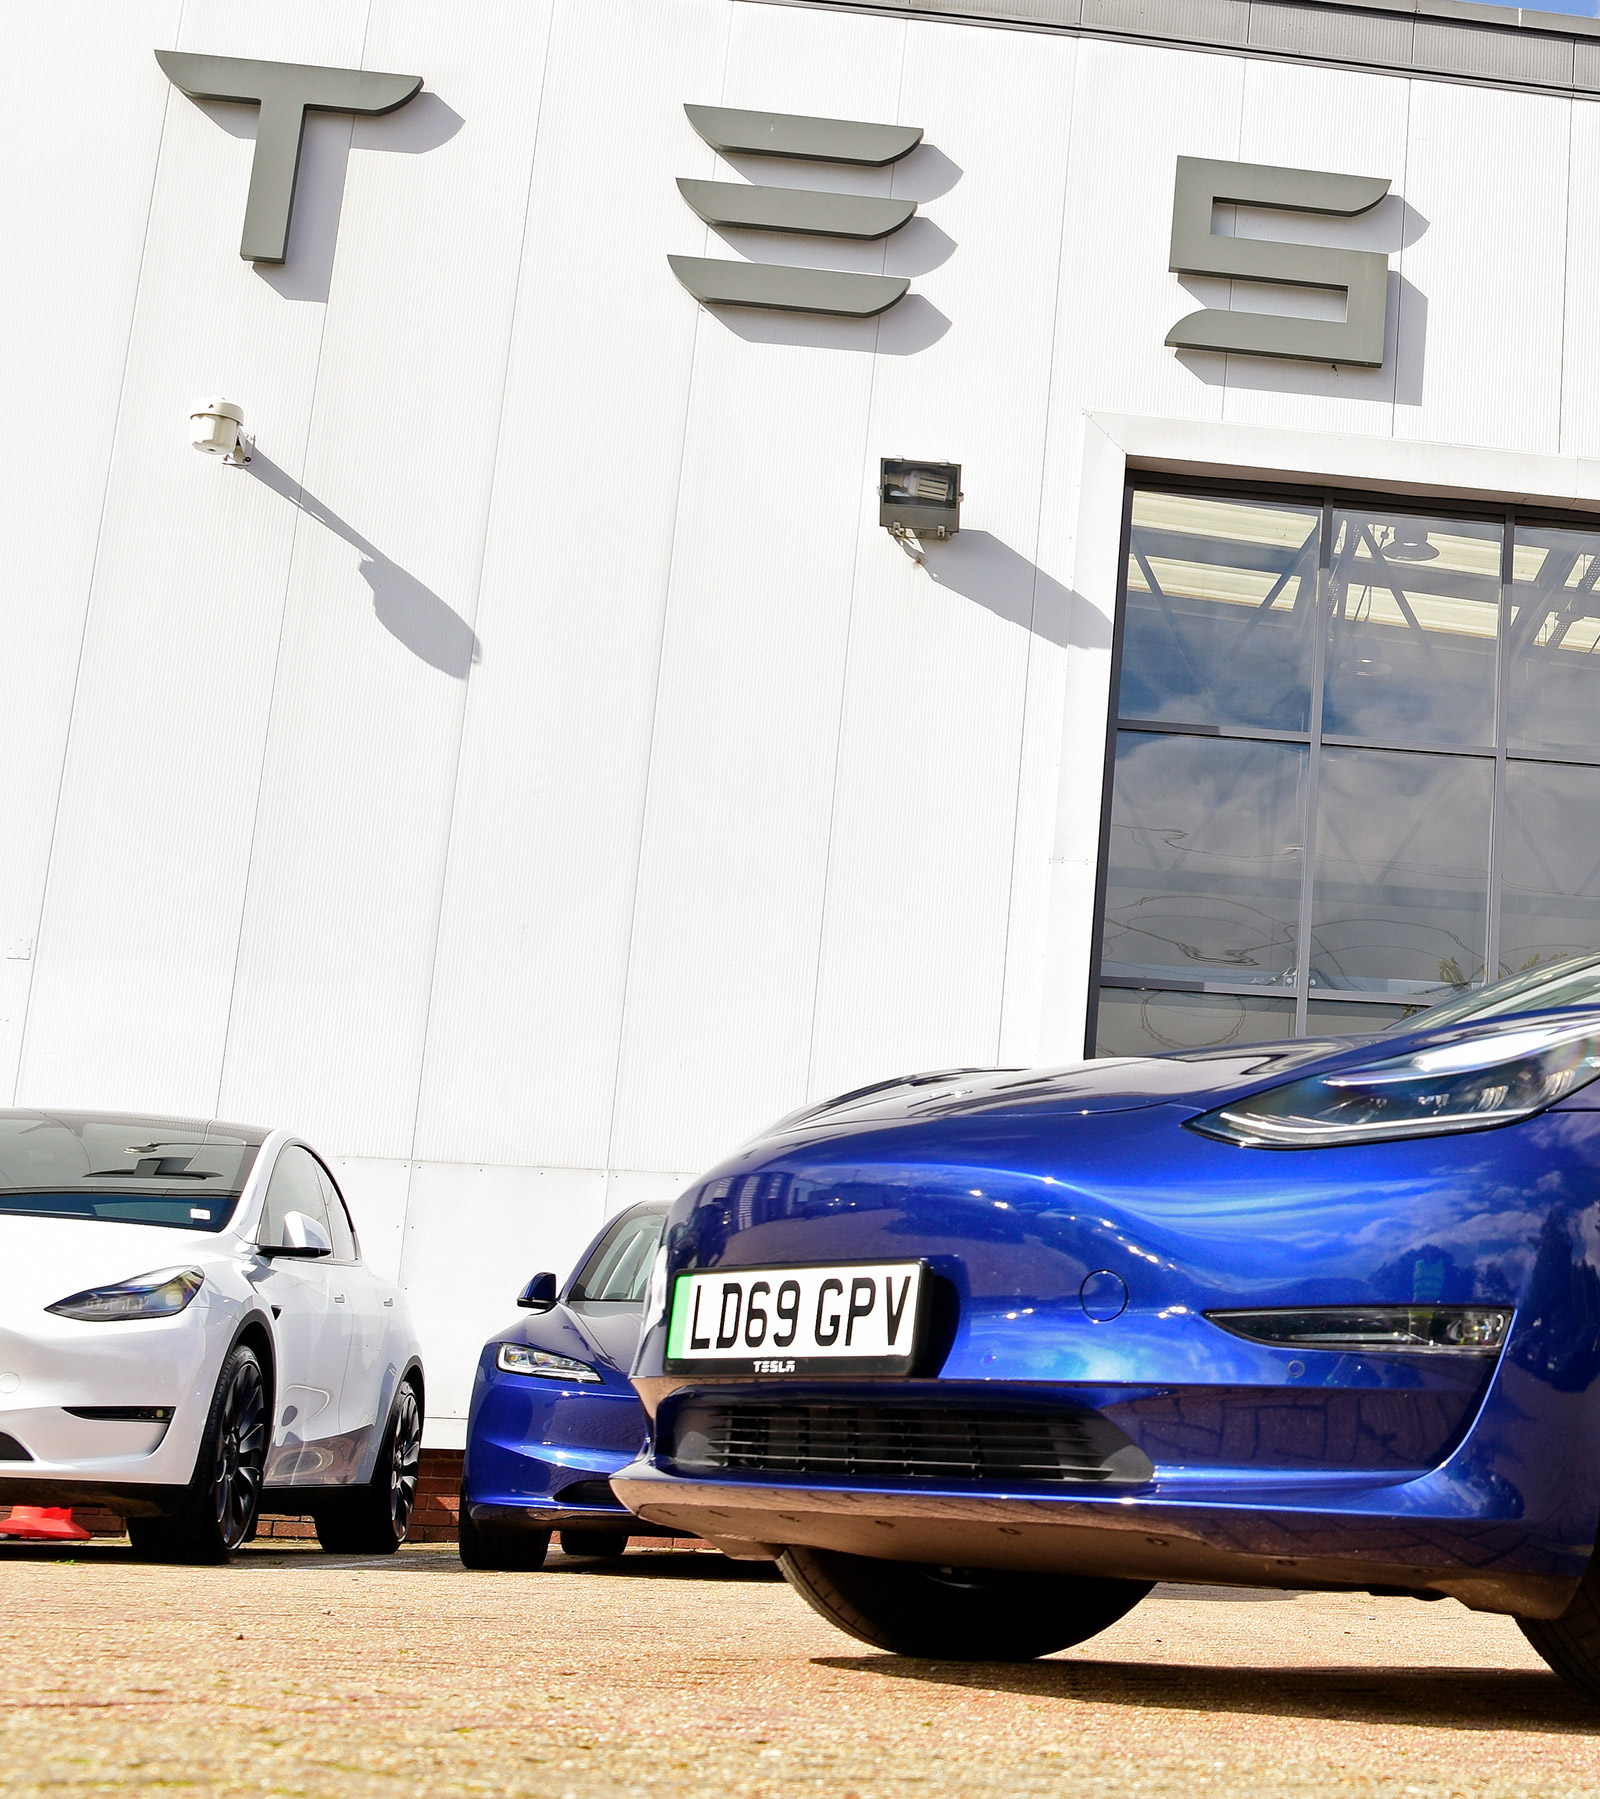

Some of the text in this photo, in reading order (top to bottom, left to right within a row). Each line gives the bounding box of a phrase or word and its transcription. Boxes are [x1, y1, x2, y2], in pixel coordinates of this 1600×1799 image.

[690, 1276, 912, 1350] LD69 GPV
[753, 1360, 795, 1373] TESLA
